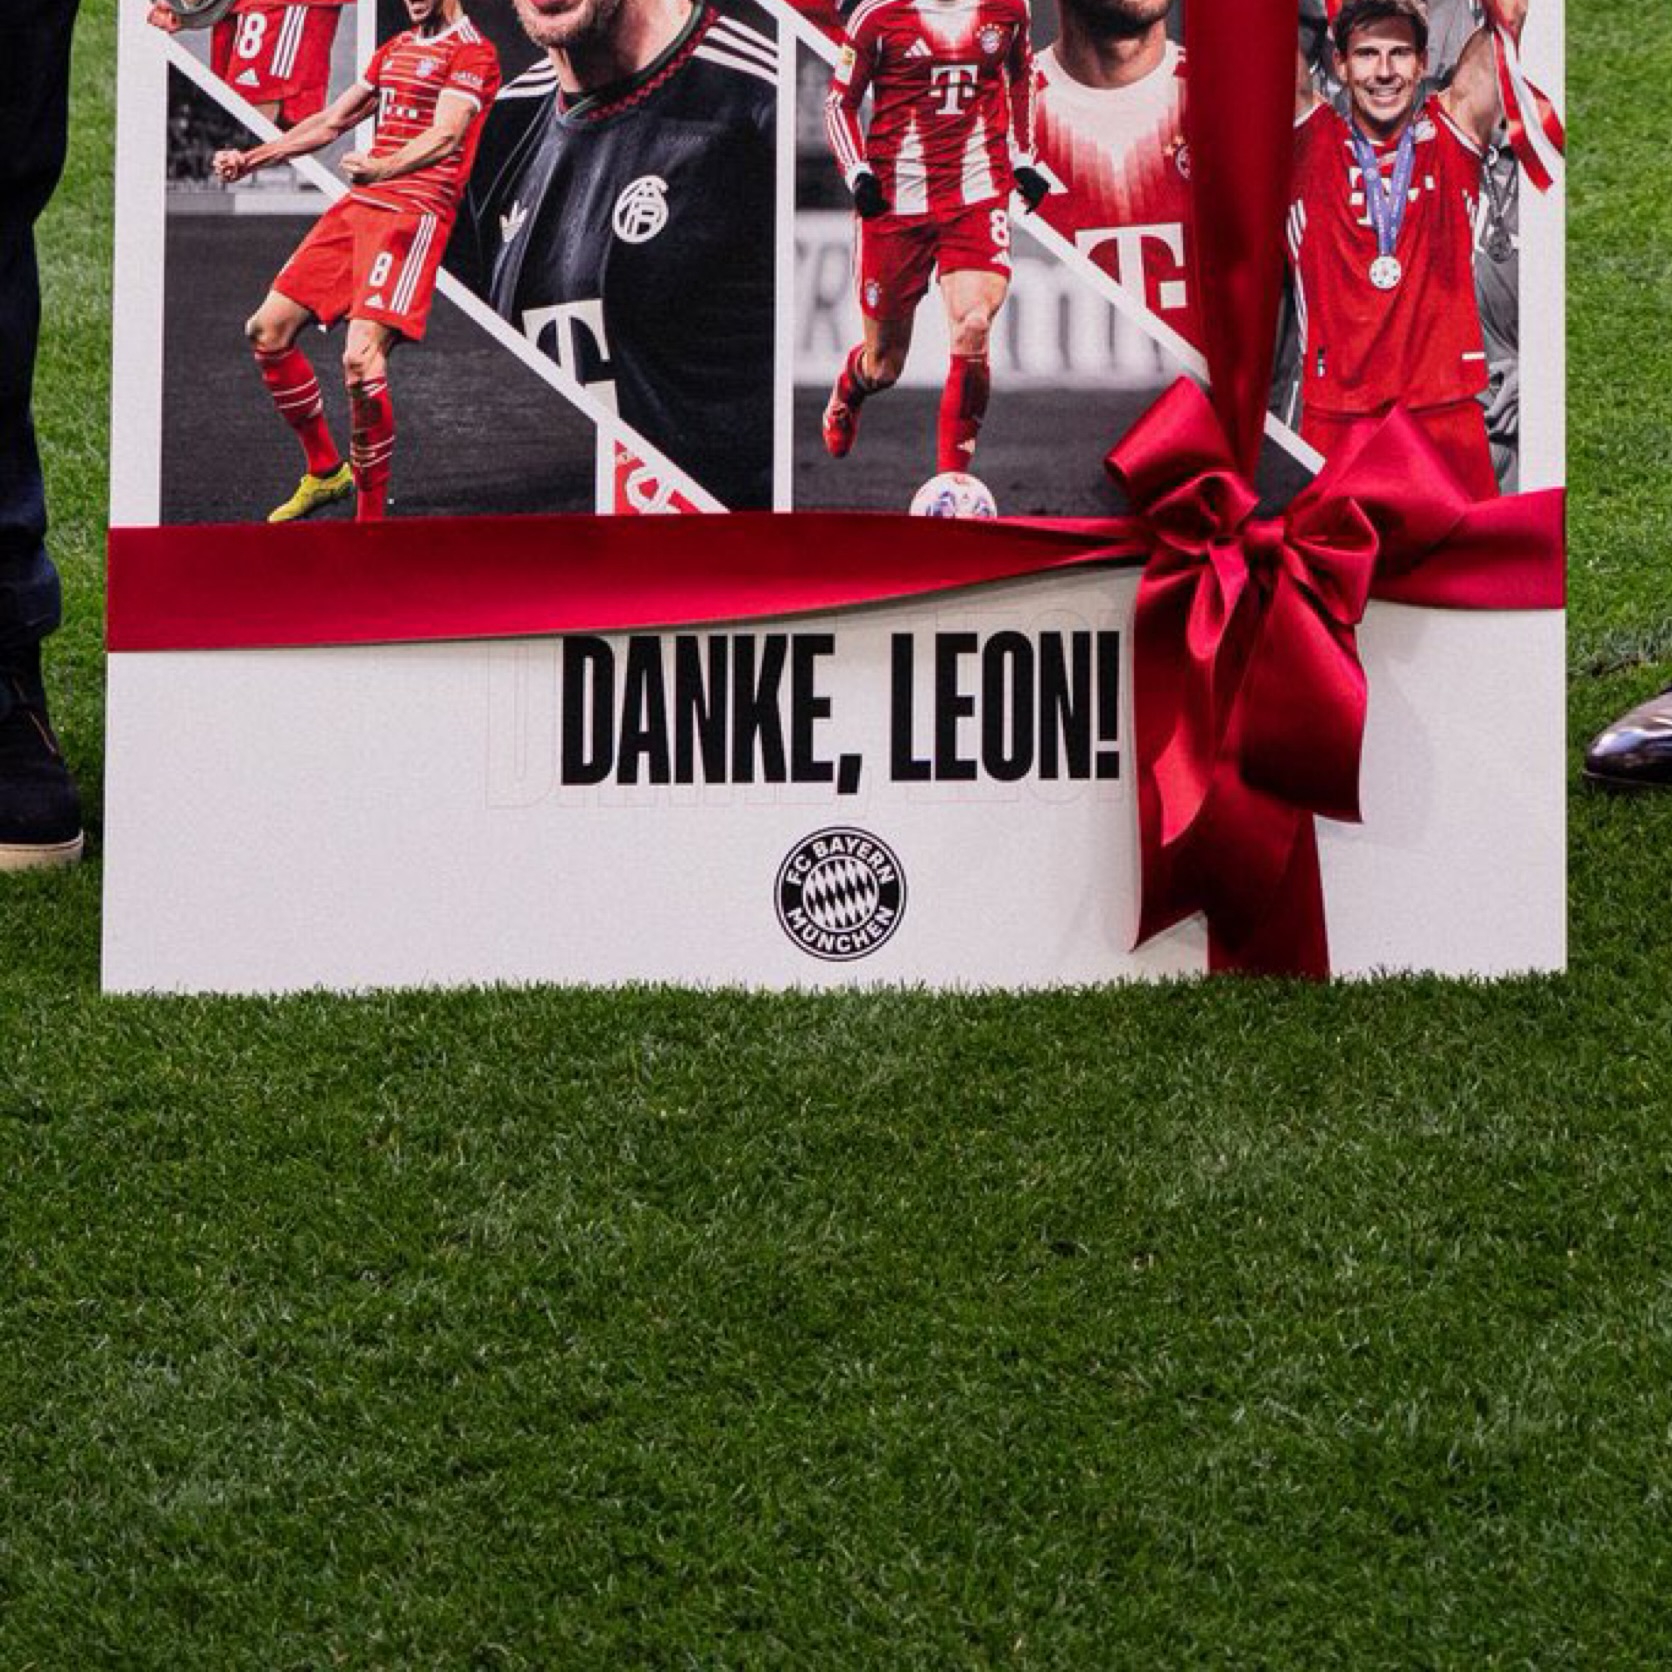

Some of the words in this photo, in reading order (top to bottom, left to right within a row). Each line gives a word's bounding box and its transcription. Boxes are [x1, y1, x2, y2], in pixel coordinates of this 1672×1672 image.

[238, 12, 267, 59] 8
[989, 207, 1011, 247] 8
[368, 251, 393, 287] 8
[560, 632, 863, 795] DANKE,
[888, 629, 1120, 782] LEON!
[785, 854, 812, 886] FC
[811, 836, 895, 885] BAYERN
